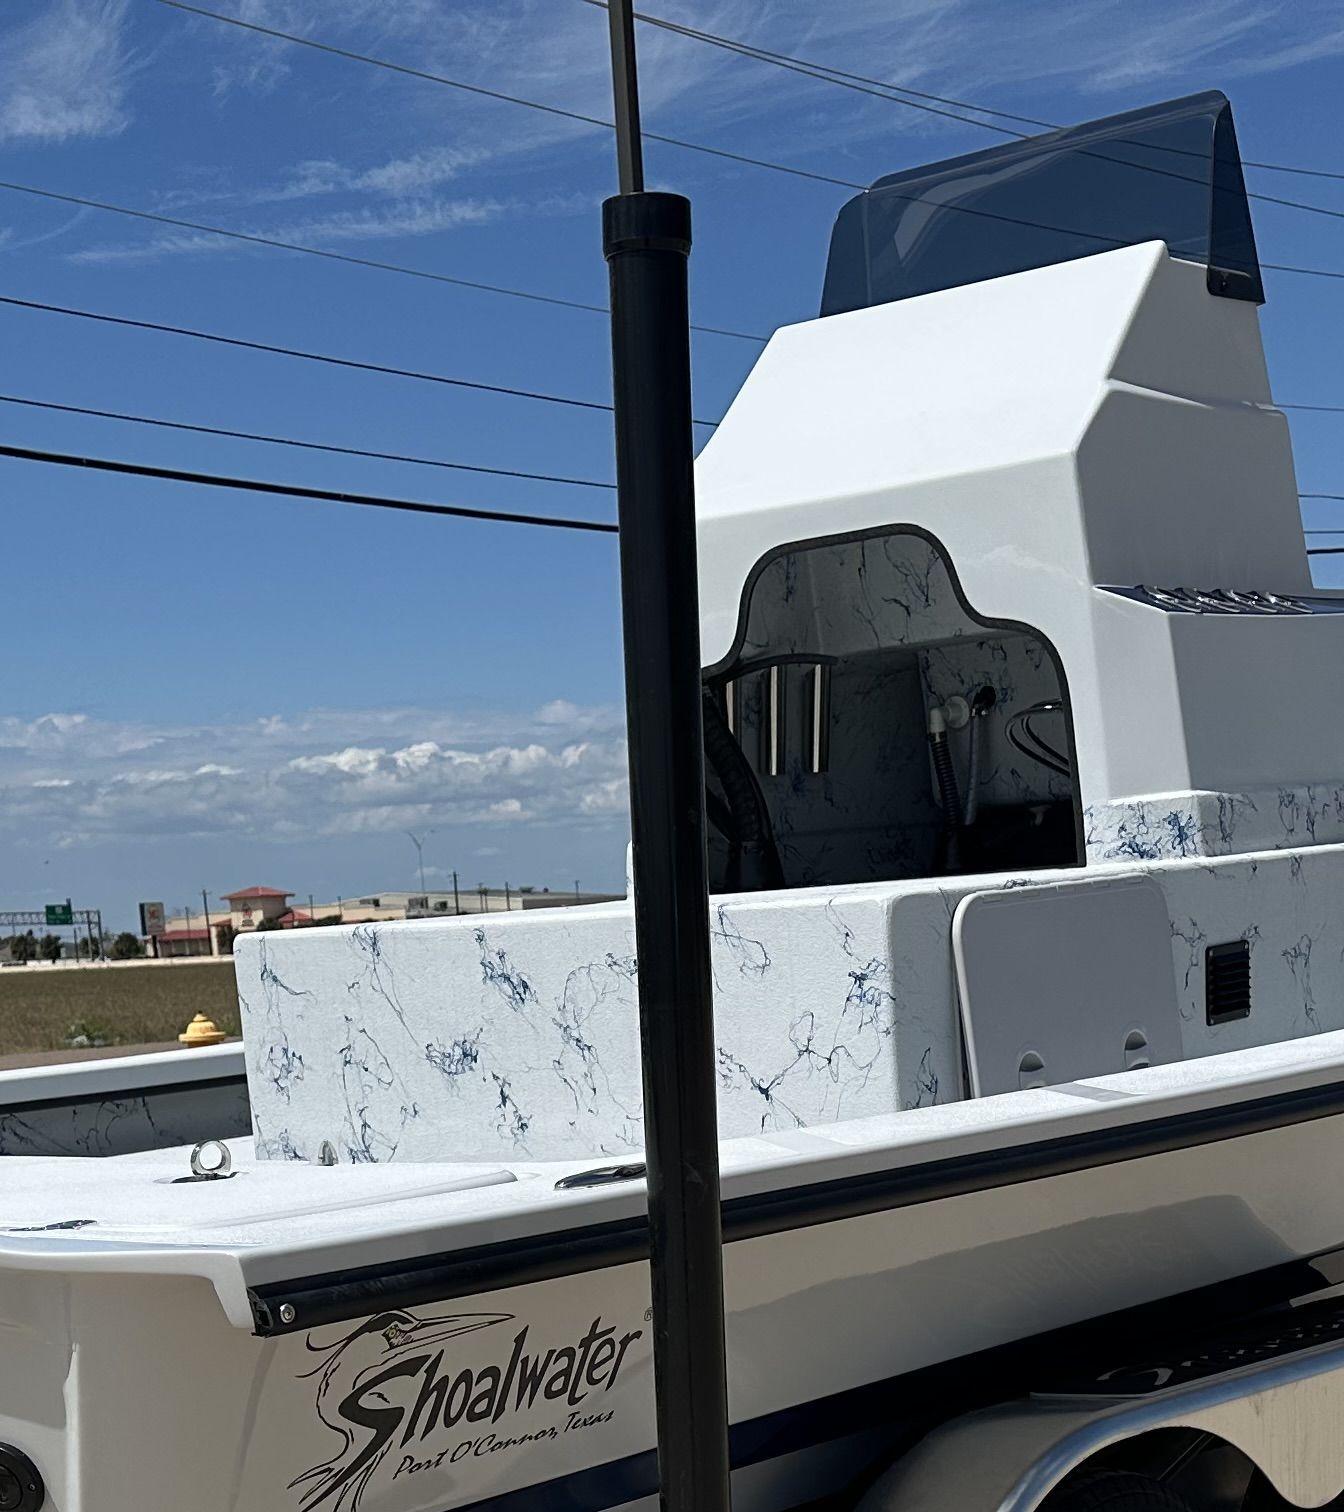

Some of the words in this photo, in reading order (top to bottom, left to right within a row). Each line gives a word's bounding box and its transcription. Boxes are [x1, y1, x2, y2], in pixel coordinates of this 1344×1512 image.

[324, 1316, 642, 1482] Shoalwater
[392, 1448, 452, 1480] Port
[453, 1424, 559, 1465] O'Connor,
[563, 1408, 615, 1434] Texas
